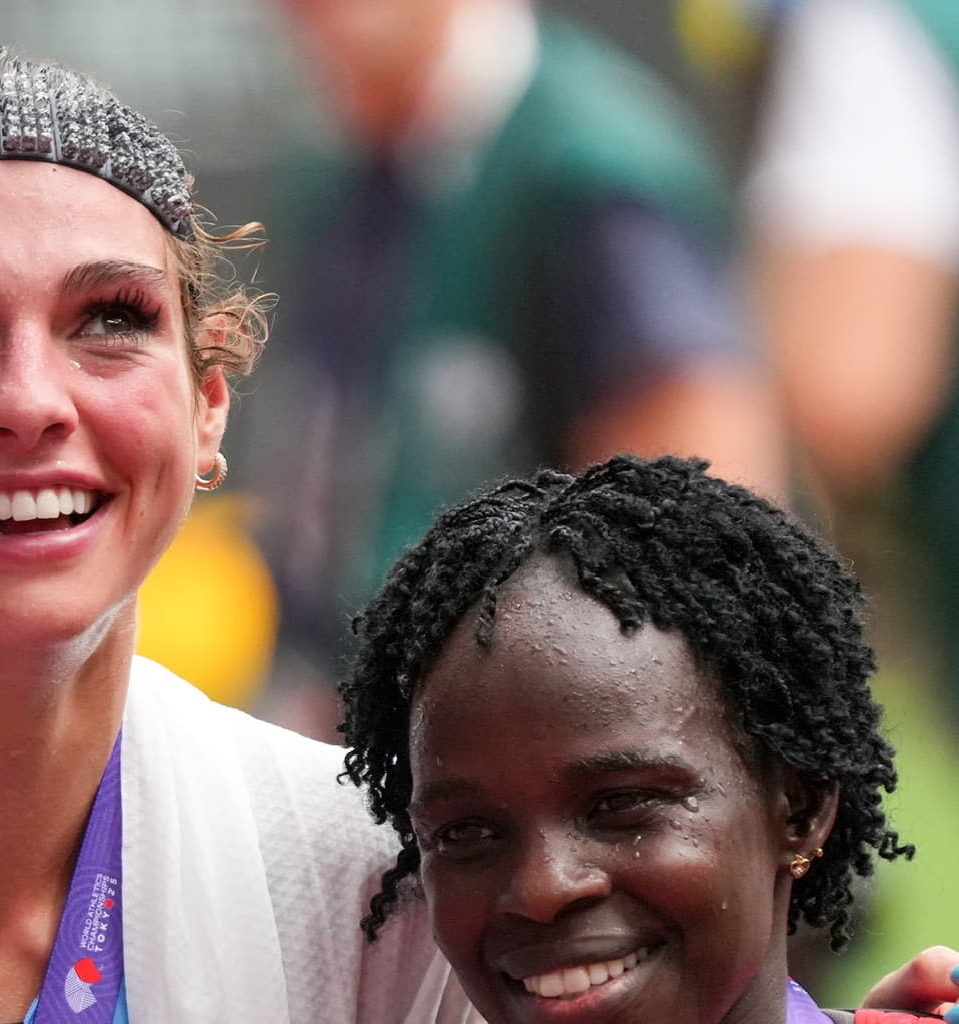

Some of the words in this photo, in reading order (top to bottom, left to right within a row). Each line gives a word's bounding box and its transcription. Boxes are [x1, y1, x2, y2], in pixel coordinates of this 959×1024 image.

[80, 918, 92, 948] WORLD
[87, 873, 103, 917] ATHLETICS
[87, 875, 110, 950] CHAMPIONSHIPS
